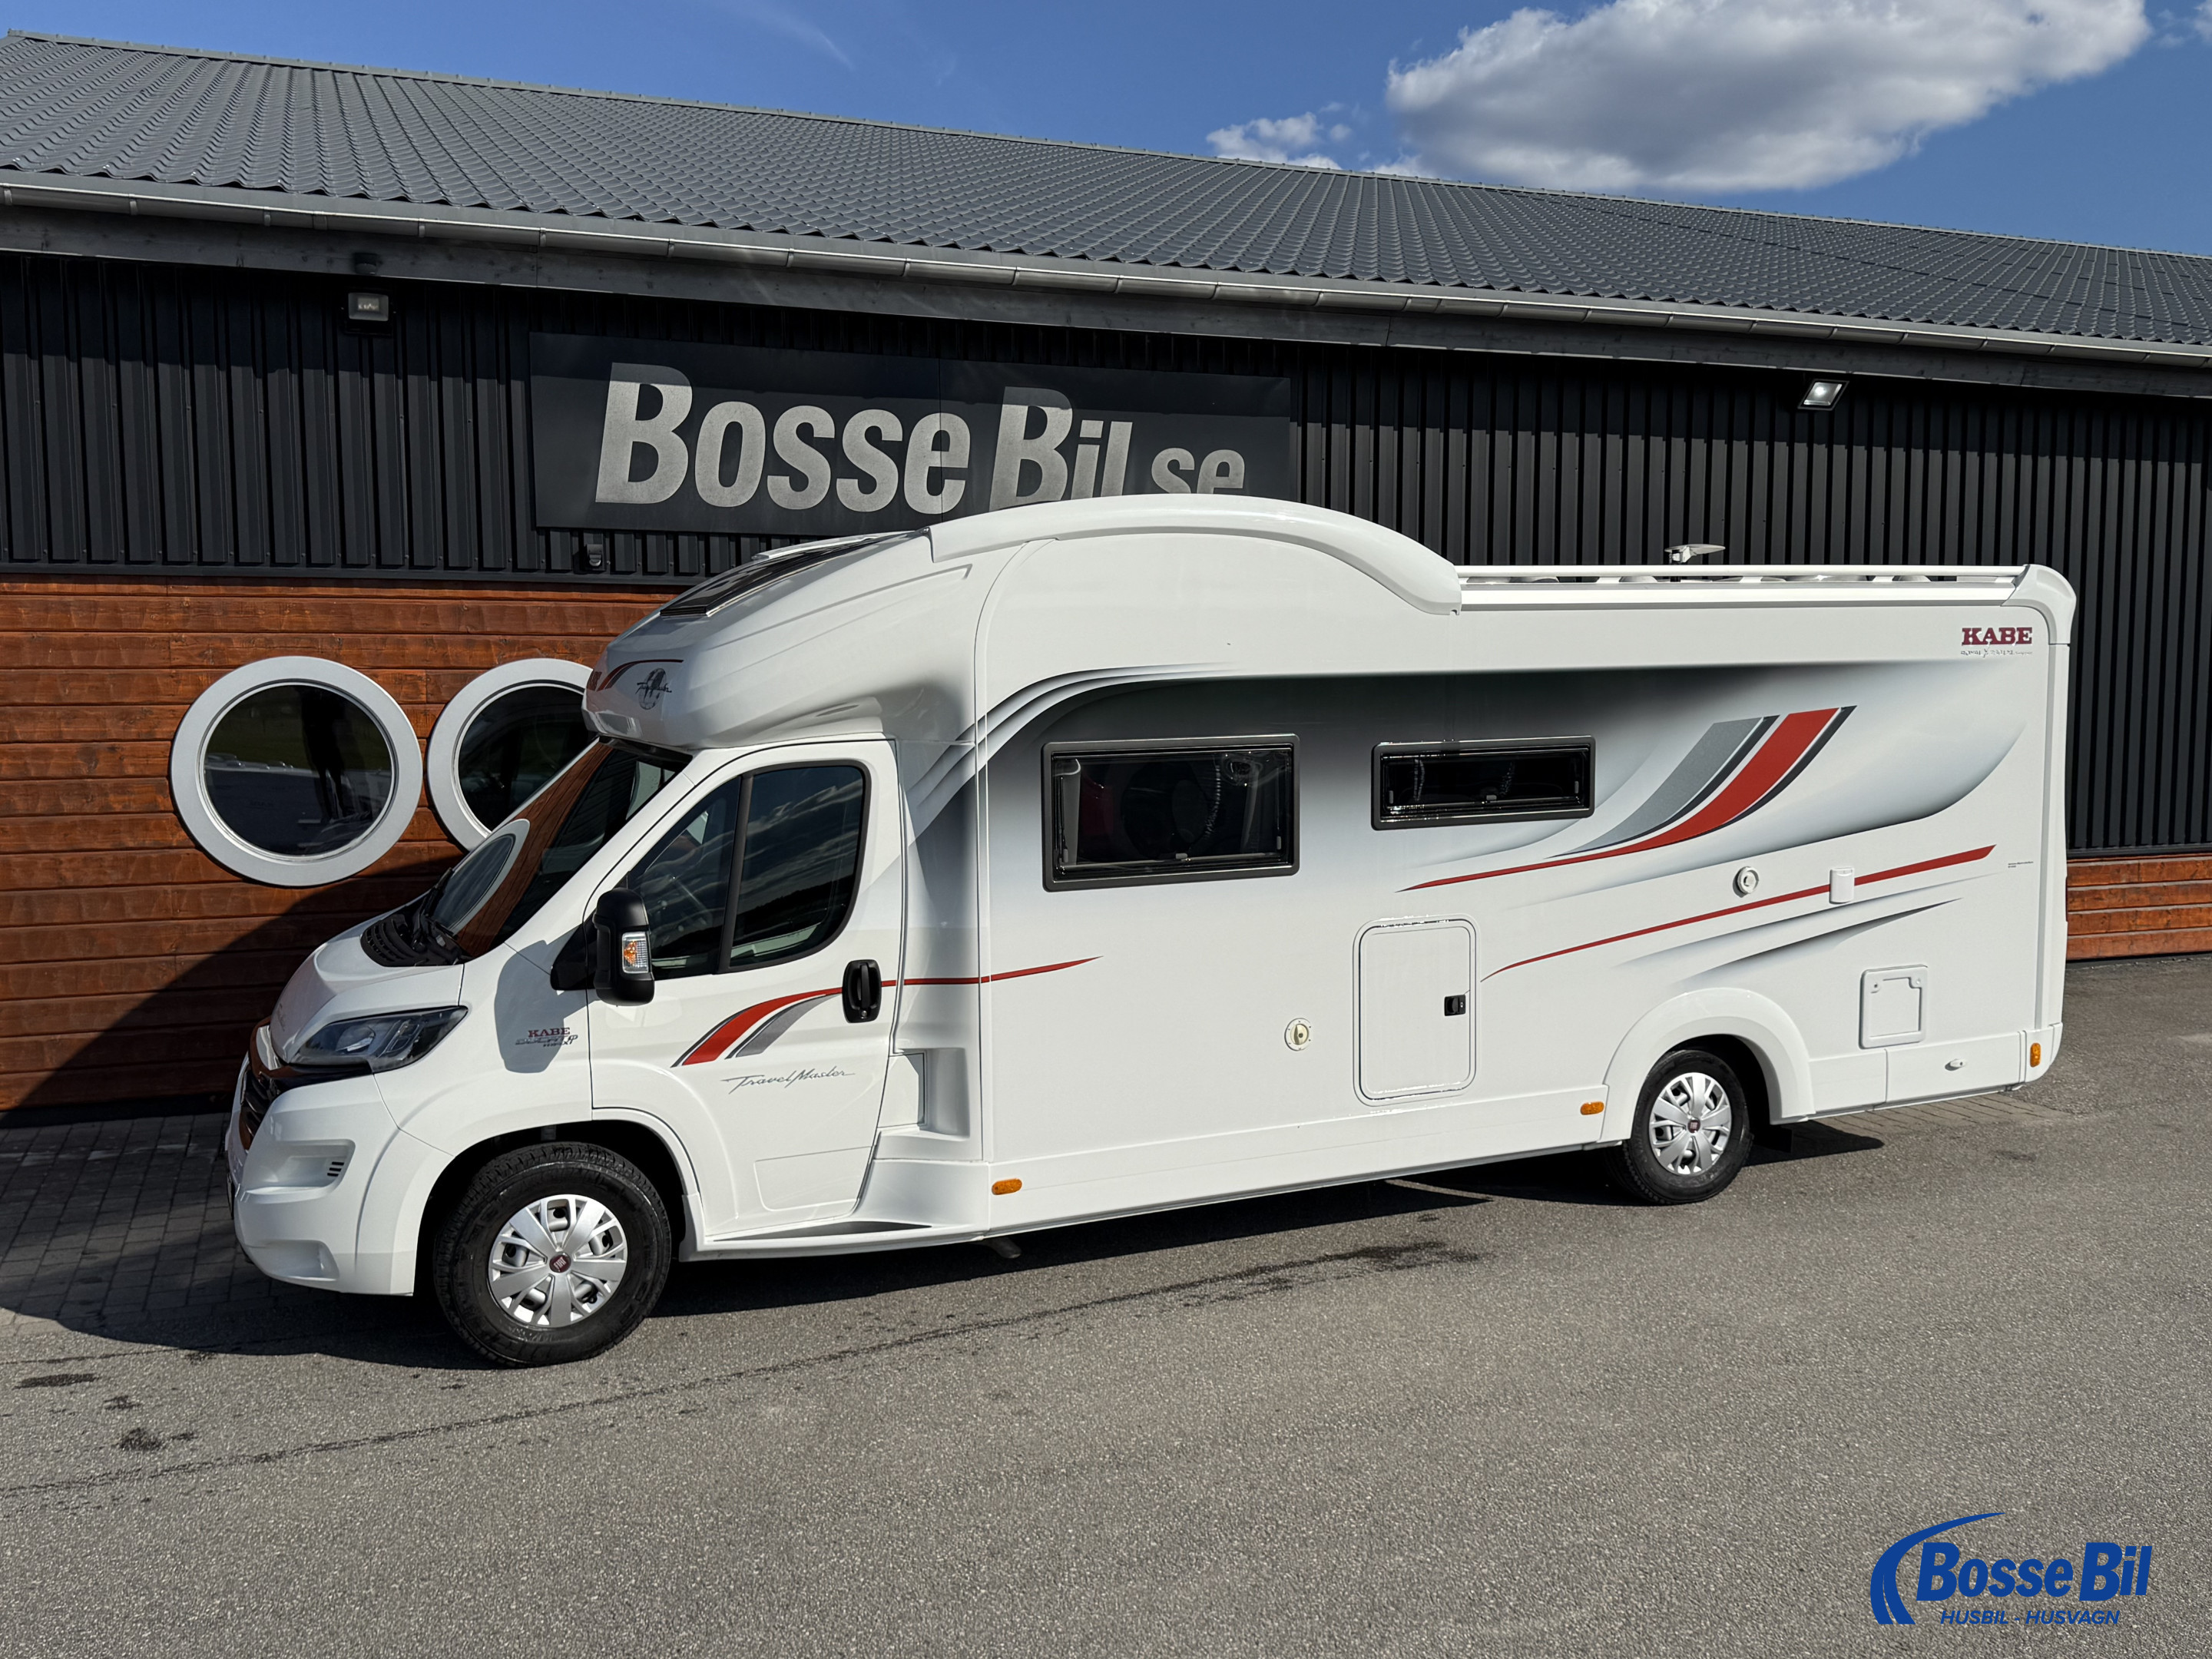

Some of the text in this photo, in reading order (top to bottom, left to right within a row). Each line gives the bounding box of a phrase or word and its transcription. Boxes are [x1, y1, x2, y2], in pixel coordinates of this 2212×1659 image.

[595, 362, 971, 515] Bosse
[988, 386, 1133, 512] Bil
[1961, 627, 2033, 646] KABE
[528, 1027, 571, 1038] KABE
